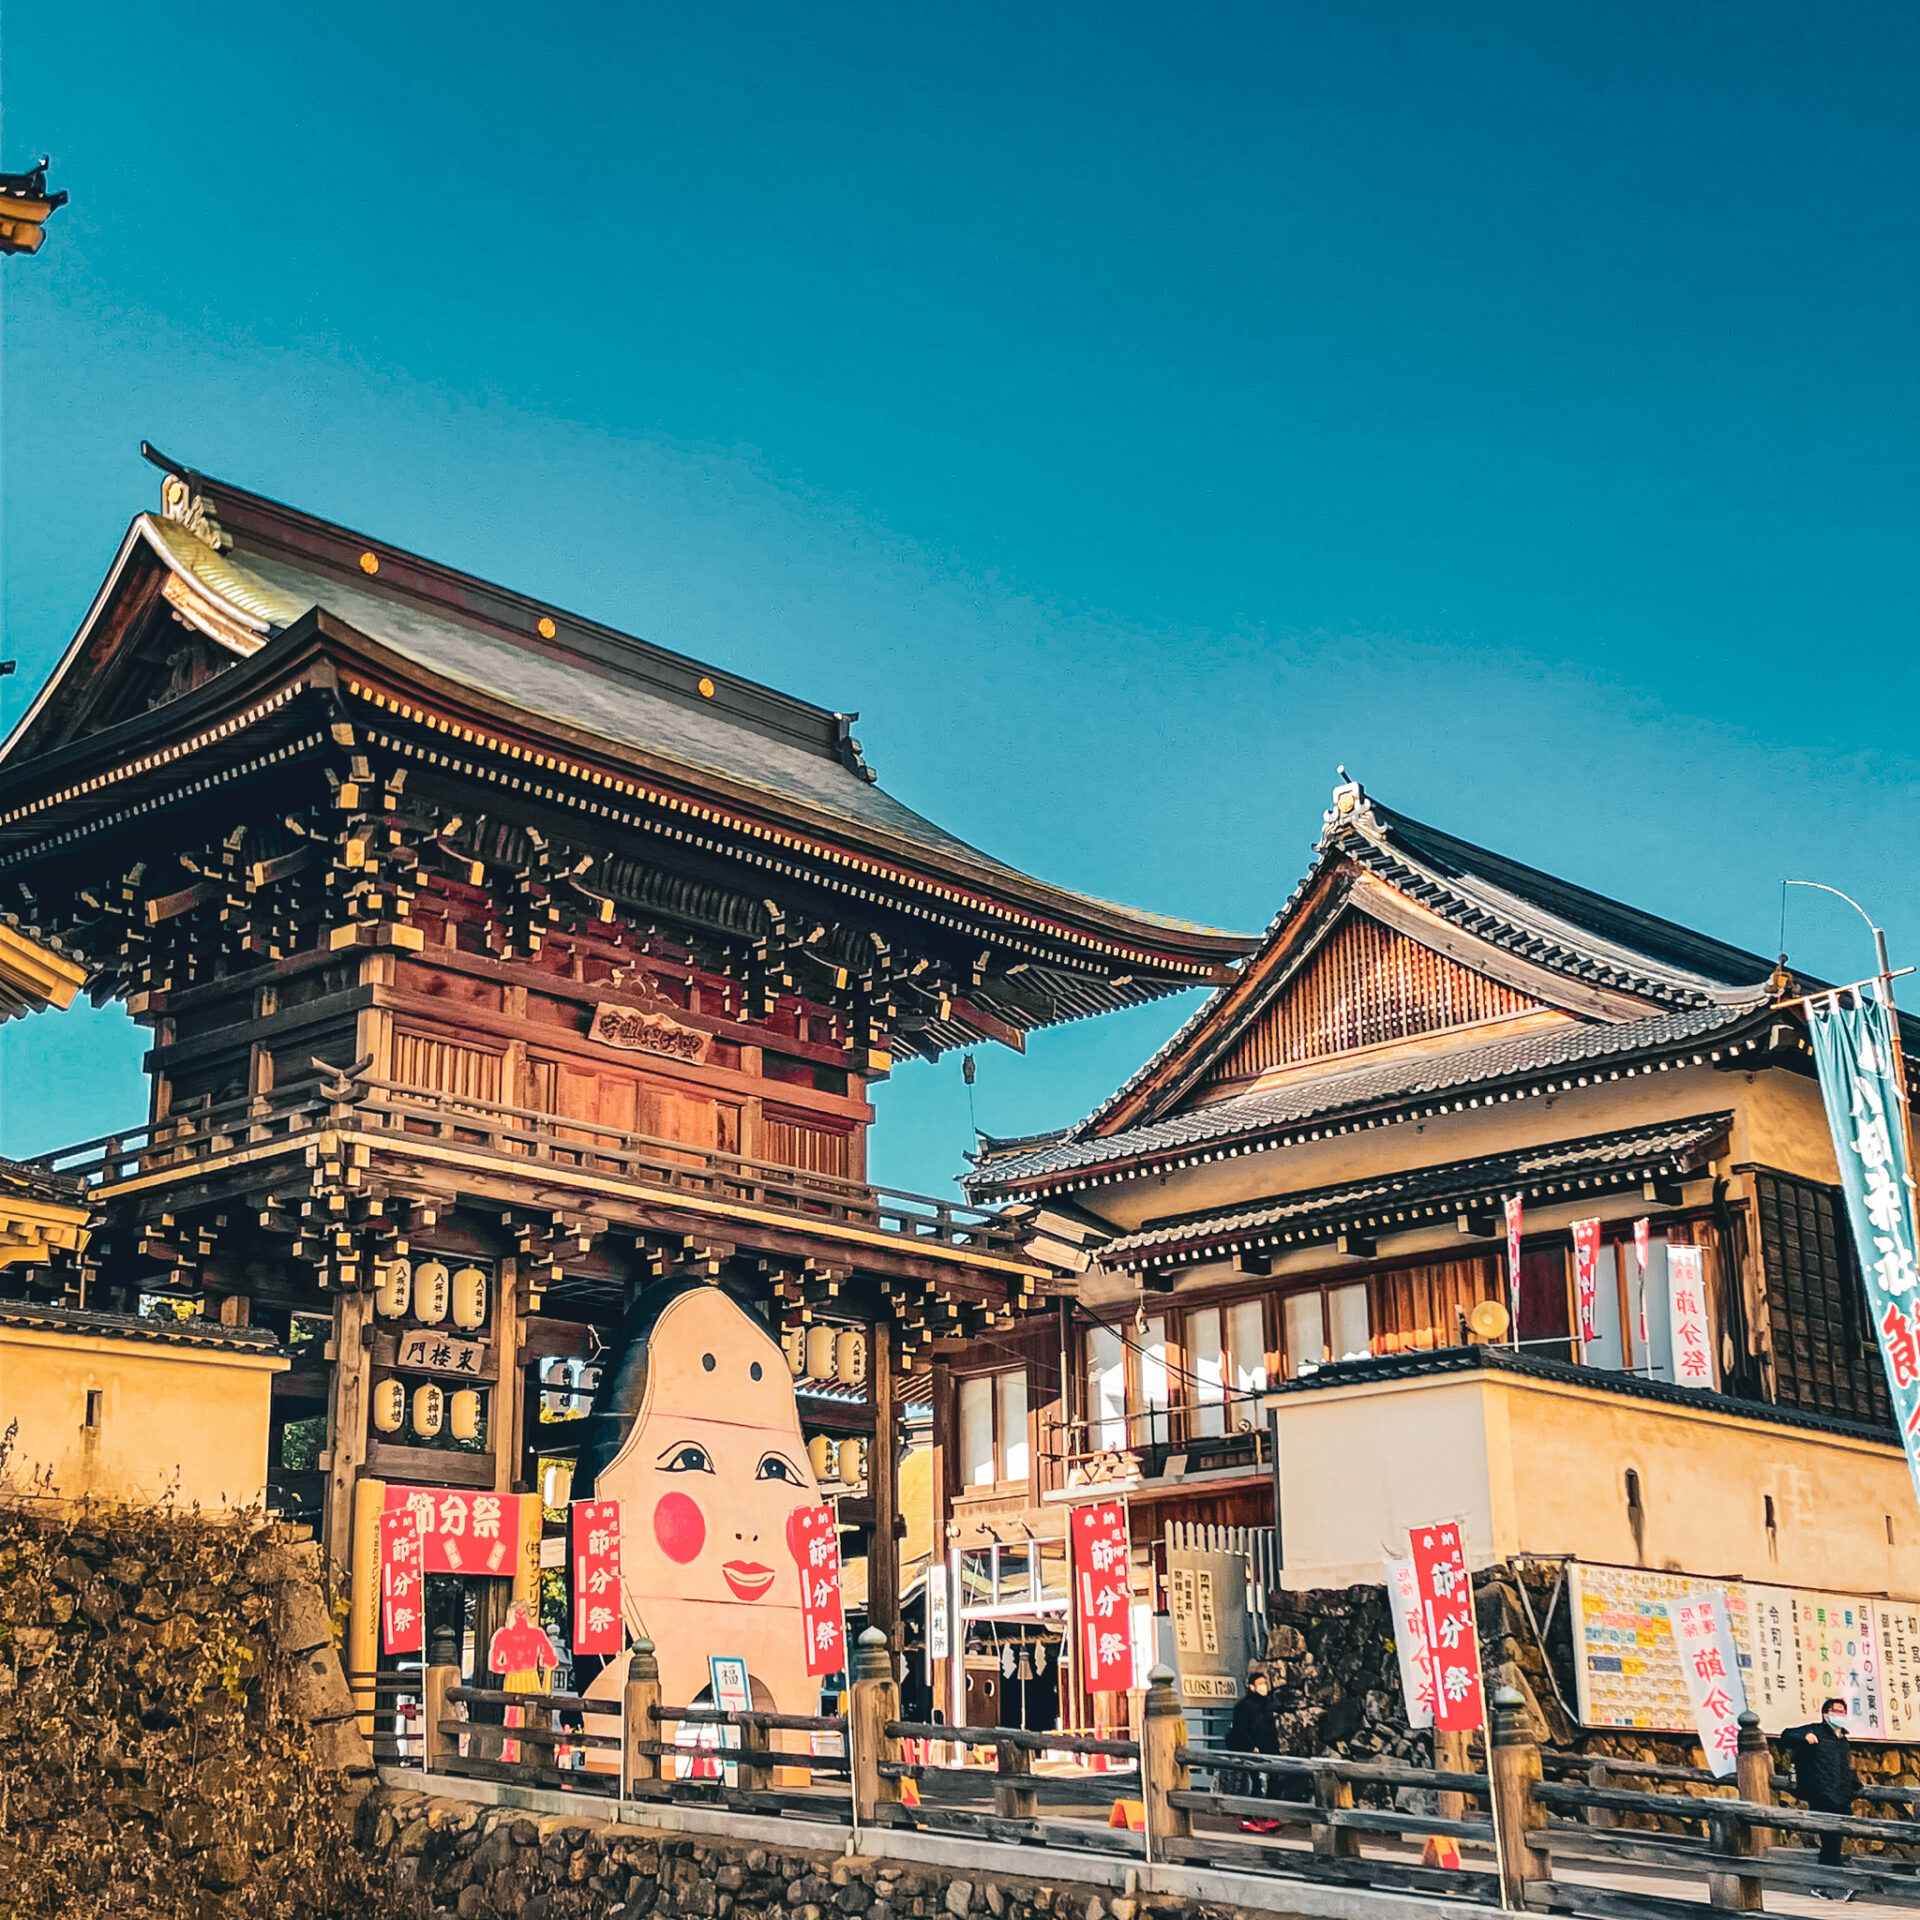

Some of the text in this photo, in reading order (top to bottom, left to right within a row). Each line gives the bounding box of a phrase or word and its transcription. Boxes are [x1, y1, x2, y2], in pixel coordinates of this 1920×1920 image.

[433, 1273, 445, 1312] 八坂神社
[407, 1492, 501, 1538] 節分祭
[392, 1536, 415, 1632] 節分祭
[588, 1529, 615, 1633] 節分祭
[809, 1537, 838, 1650] 節分祭
[1091, 1538, 1127, 1665] 節分祭
[721, 1662, 738, 1685] 福
[1431, 1561, 1472, 1702] 節分祭
[1184, 1679, 1211, 1694] CLOSE
